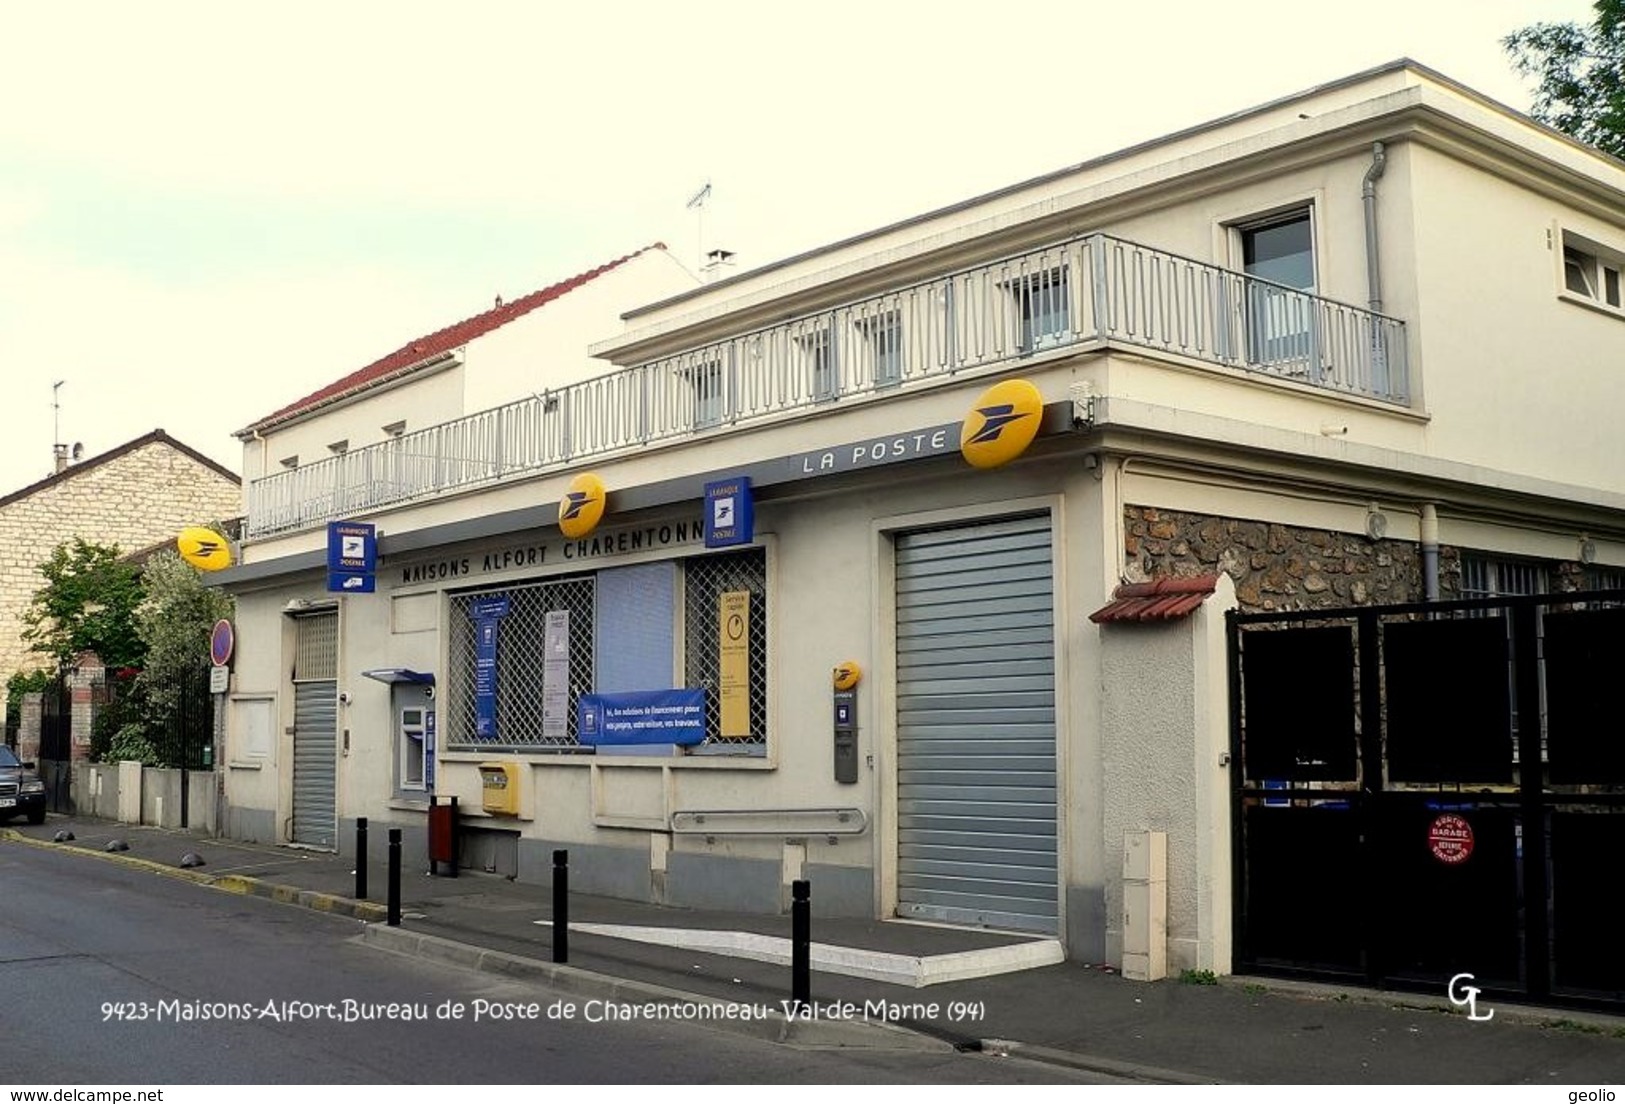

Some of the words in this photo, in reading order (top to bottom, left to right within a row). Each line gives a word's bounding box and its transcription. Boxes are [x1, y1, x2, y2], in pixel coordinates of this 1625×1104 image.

[803, 453, 834, 473] LA
[853, 431, 946, 463] POSTE
[403, 560, 469, 582] MAISONS
[483, 546, 547, 572] ALFORT
[1432, 828, 1468, 838] GARAGE
